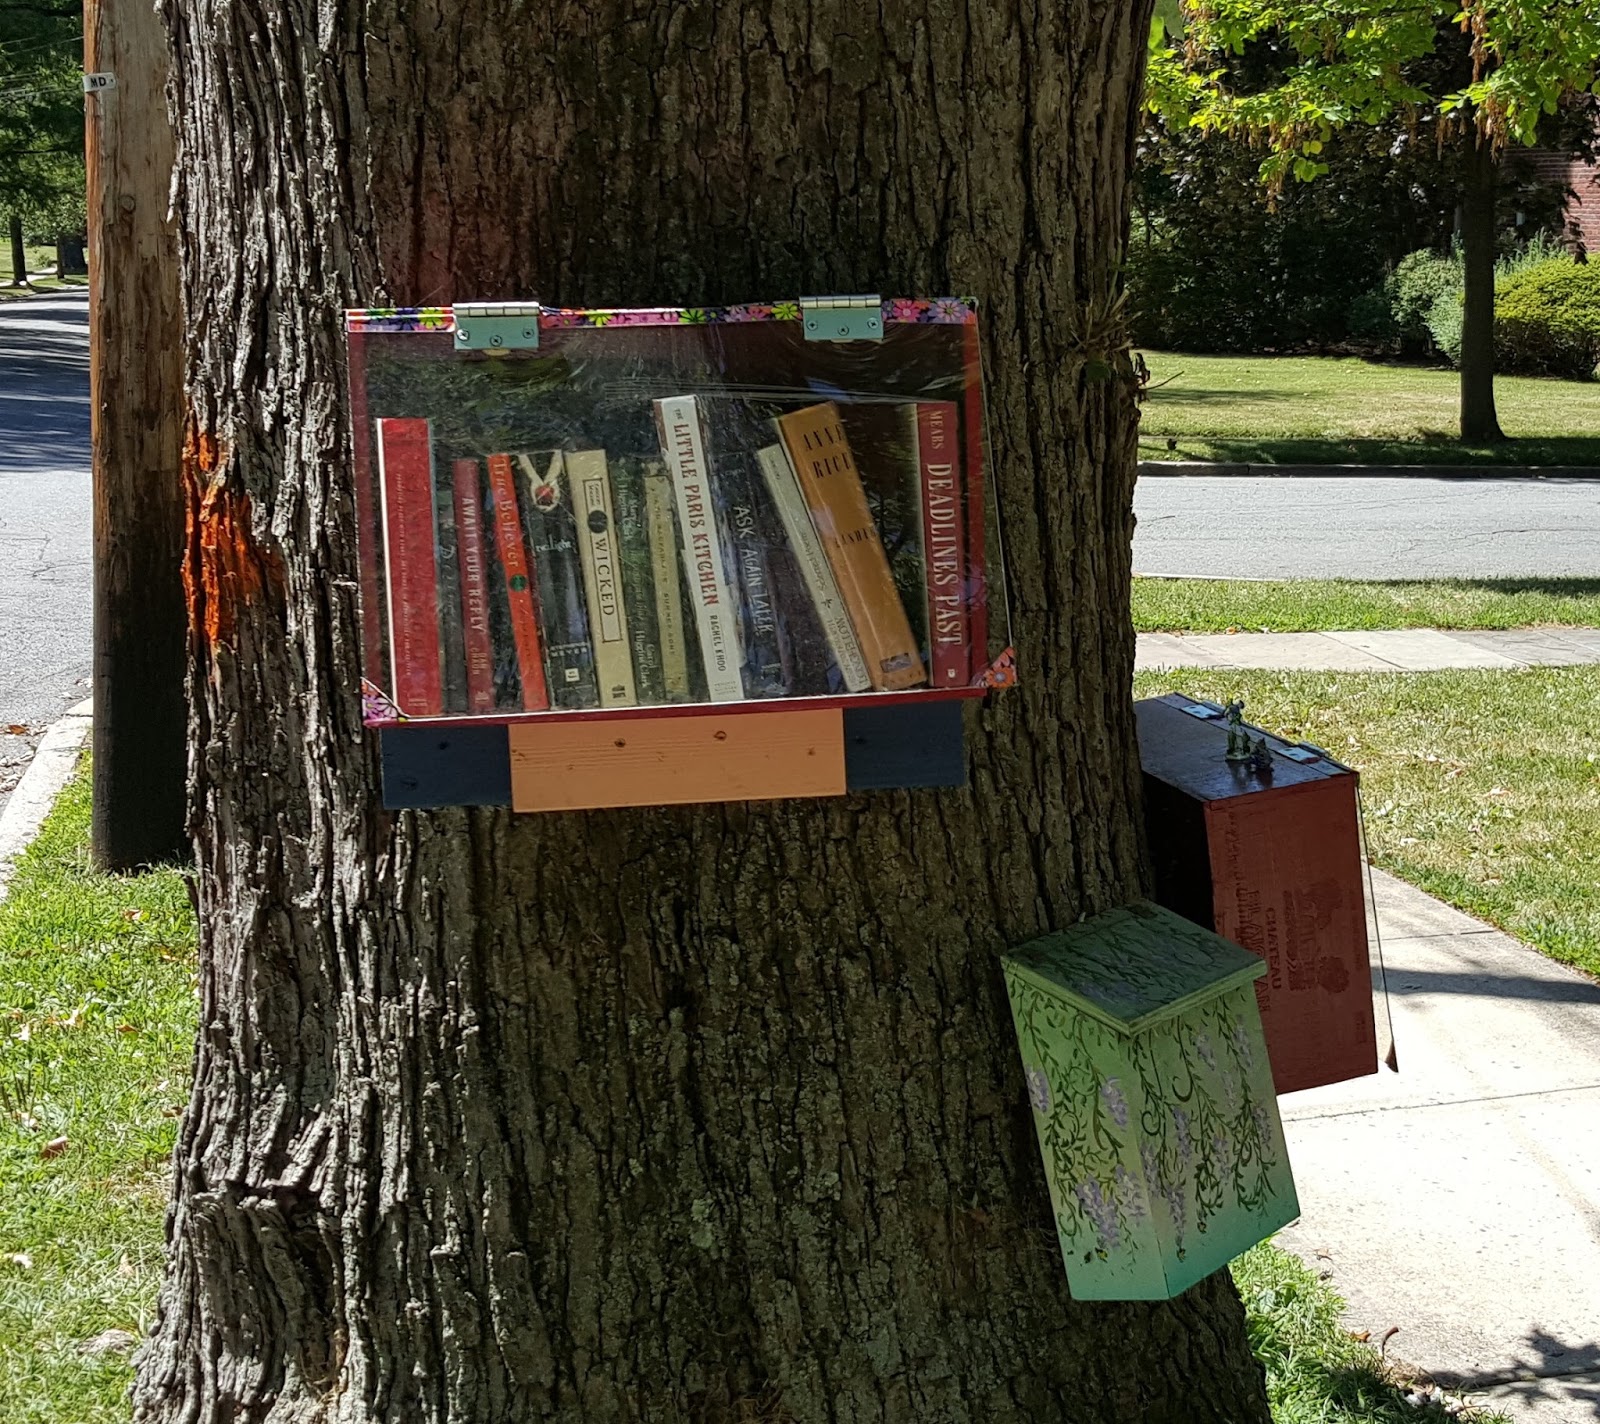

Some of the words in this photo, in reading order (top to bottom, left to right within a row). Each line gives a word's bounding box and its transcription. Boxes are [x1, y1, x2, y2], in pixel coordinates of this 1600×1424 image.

[90, 76, 107, 88] MD
[929, 409, 944, 450] MEARS
[673, 423, 698, 480] LITTLE
[492, 458, 508, 495] True
[461, 497, 478, 540] AWAIT
[683, 484, 706, 529] PARIS
[733, 505, 757, 539] ASK
[926, 463, 960, 587] DEADLINES
[499, 499, 519, 568] Believer
[465, 545, 481, 582] YOUR
[593, 537, 616, 616] WICKED
[691, 533, 721, 607] KITCHEN
[742, 548, 765, 588] AGAIN
[468, 588, 487, 635] REPLY
[709, 614, 722, 647] RACHEL
[934, 593, 963, 646] PAST
[645, 643, 657, 669] Carol
[715, 648, 727, 672] KHOO
[1265, 907, 1282, 990] CHATEAU
